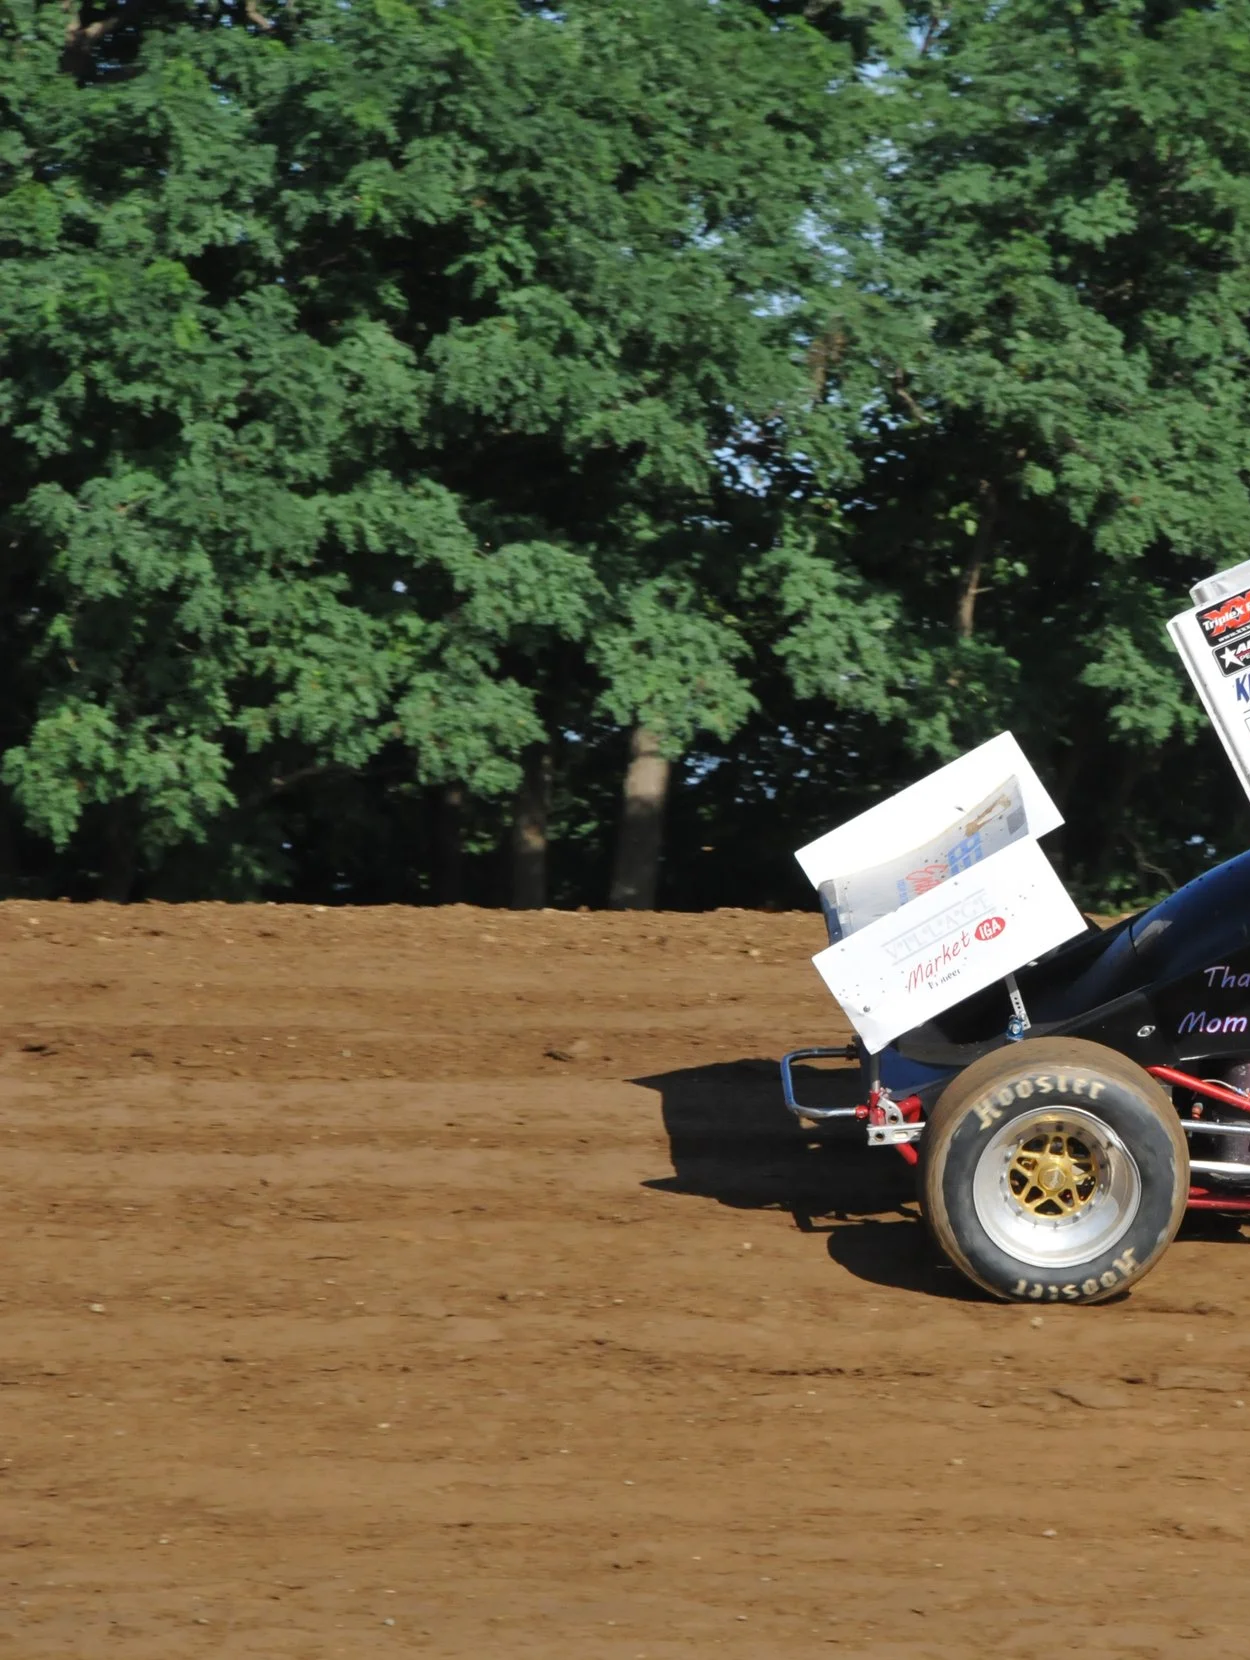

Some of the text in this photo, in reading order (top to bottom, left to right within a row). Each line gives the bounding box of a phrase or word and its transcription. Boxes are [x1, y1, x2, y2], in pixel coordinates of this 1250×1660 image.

[908, 918, 1001, 994] Market IGA
[1177, 1011, 1248, 1034] Mom
[971, 1074, 1109, 1131] Hoosier
